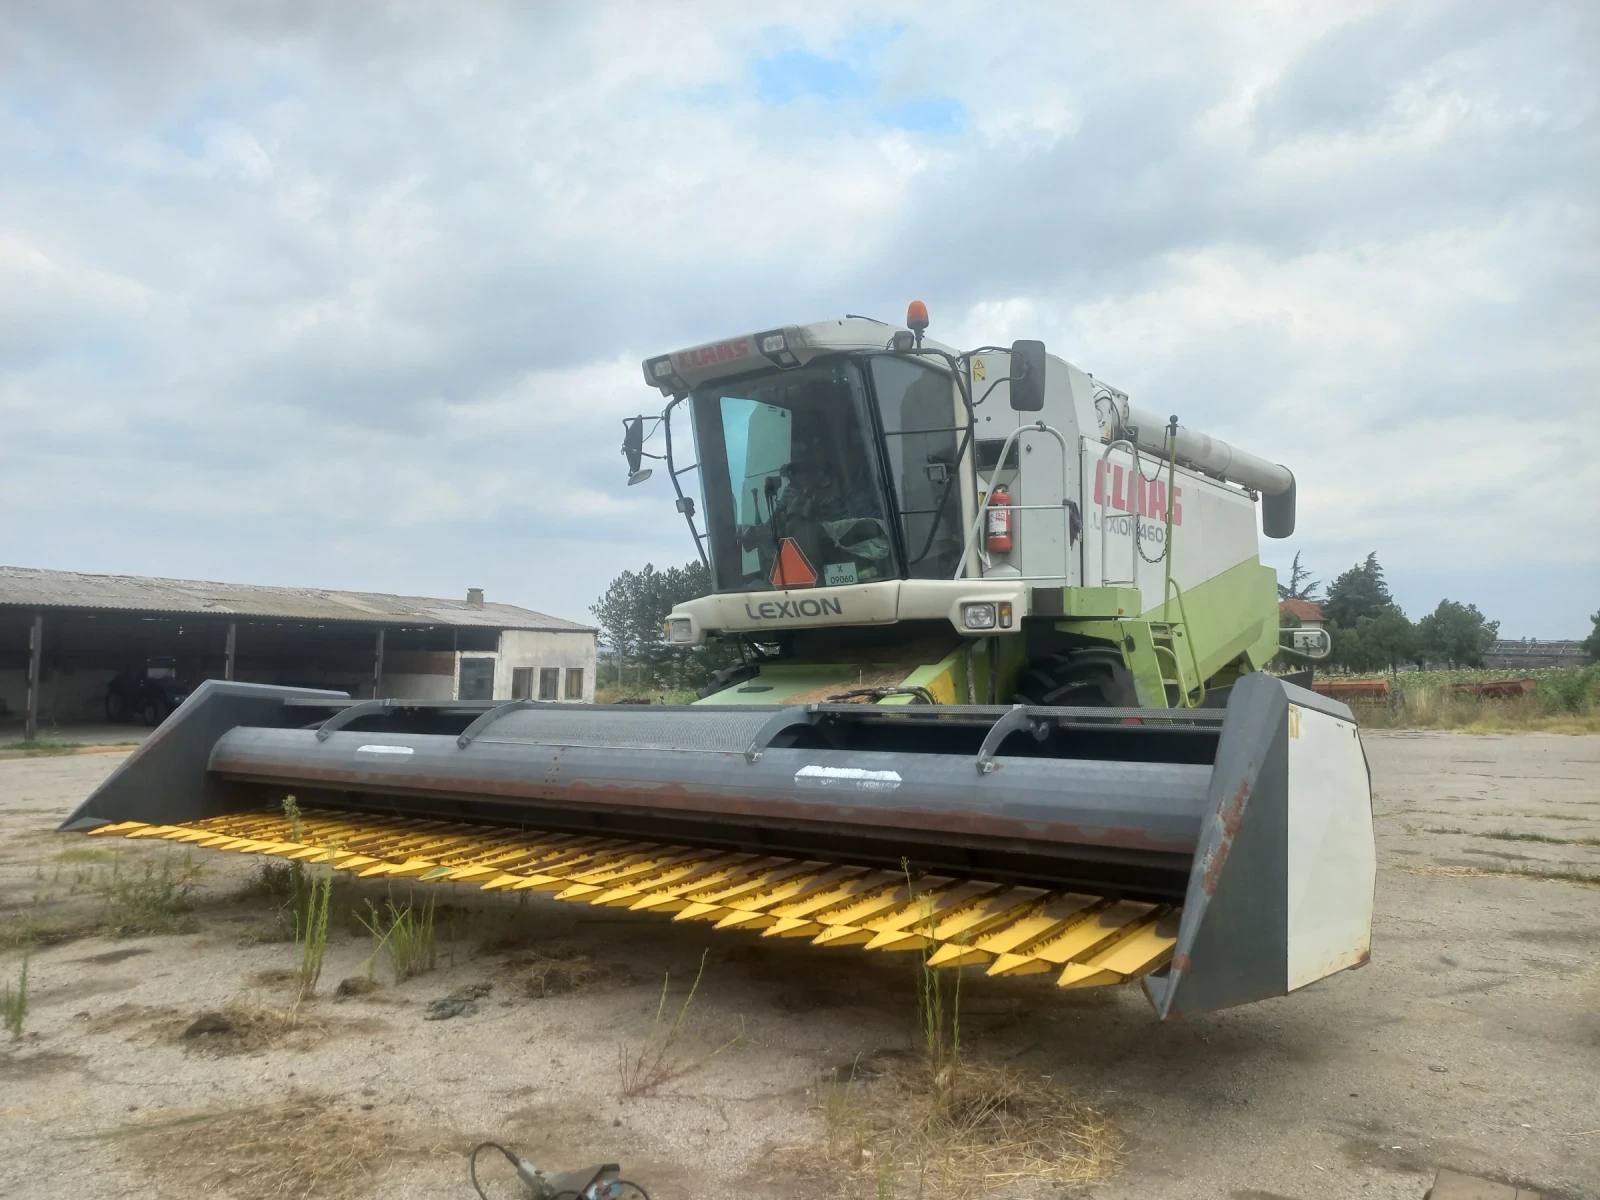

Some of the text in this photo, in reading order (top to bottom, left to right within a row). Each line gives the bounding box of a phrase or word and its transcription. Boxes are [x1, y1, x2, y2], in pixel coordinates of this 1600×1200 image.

[677, 340, 749, 369] CLAAS
[1139, 523, 1164, 543] 460
[836, 565, 844, 573] X
[830, 574, 854, 585] 09060
[744, 596, 843, 620] LEXION
